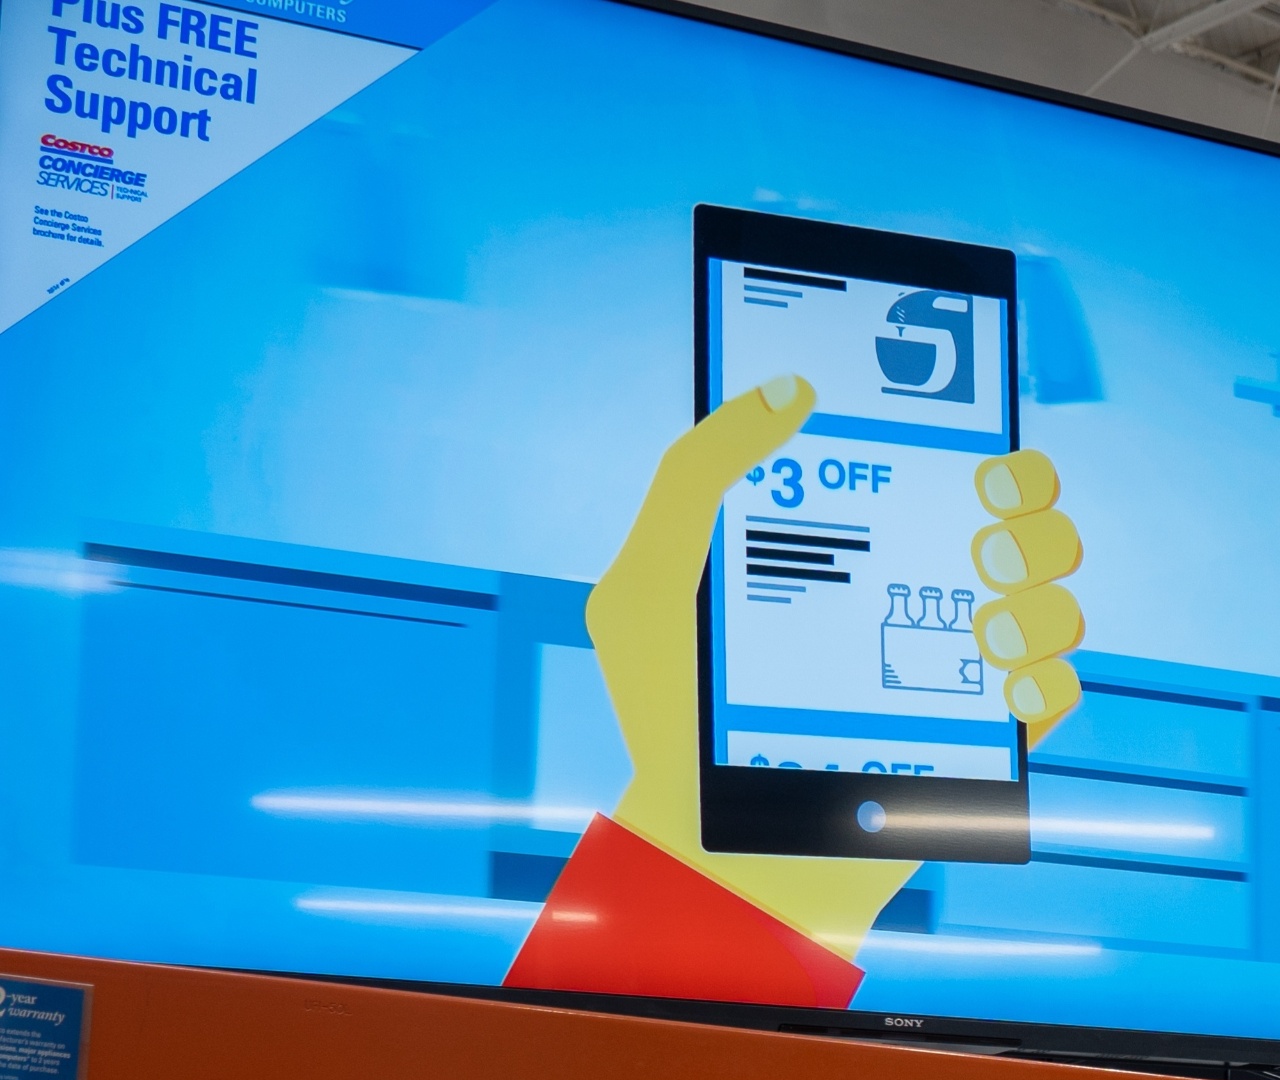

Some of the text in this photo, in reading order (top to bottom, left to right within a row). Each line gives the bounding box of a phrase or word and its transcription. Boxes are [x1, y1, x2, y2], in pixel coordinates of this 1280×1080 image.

[158, 3, 258, 58] FREE
[48, 26, 257, 104] Technical
[44, 74, 211, 141] Support
[41, 134, 114, 158] COSTCO
[36, 171, 109, 196] SERVICES
[39, 155, 147, 187] CONCIERGE
[34, 206, 88, 222] See the Costco
[34, 216, 102, 236] Concierge Services
[819, 459, 891, 493] OFF
[8, 1006, 65, 1026] warranty
[885, 1018, 924, 1027] SONY
